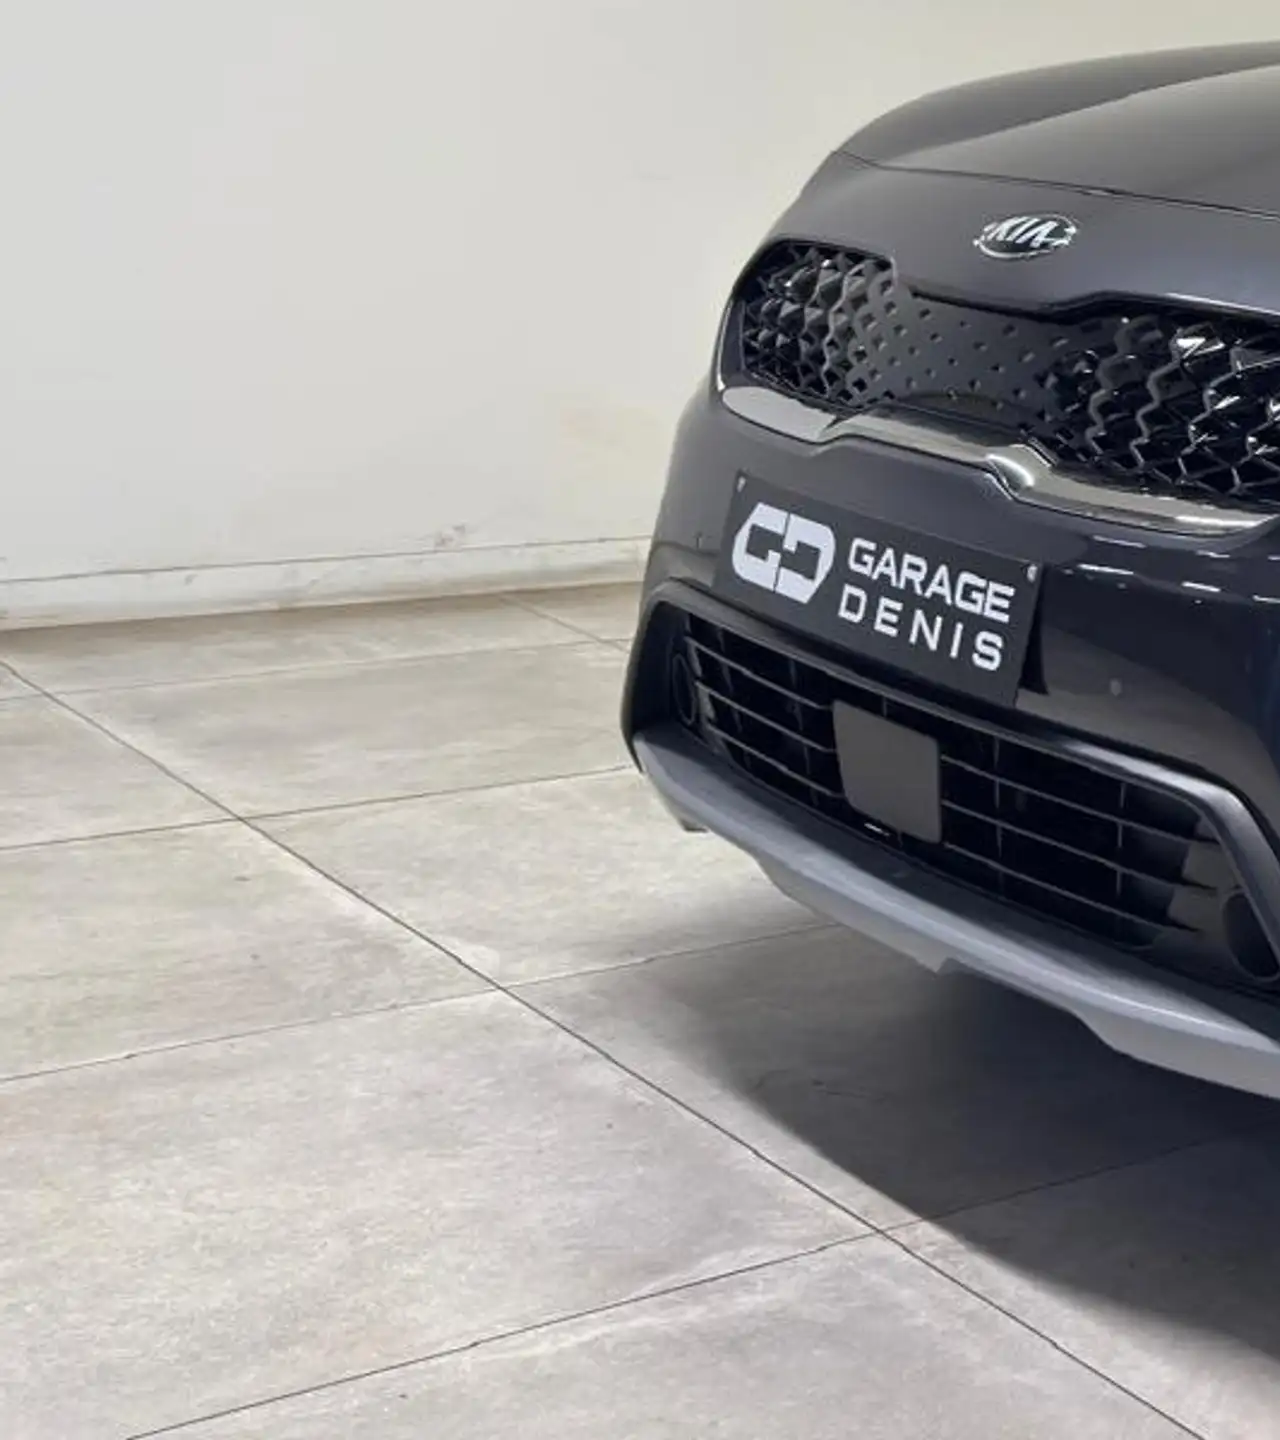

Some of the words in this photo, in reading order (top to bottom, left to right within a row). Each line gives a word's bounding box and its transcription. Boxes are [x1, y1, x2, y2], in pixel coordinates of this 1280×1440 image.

[983, 216, 1059, 249] KIA
[847, 536, 1016, 624] GARAGE
[837, 582, 1004, 672] DENIS
